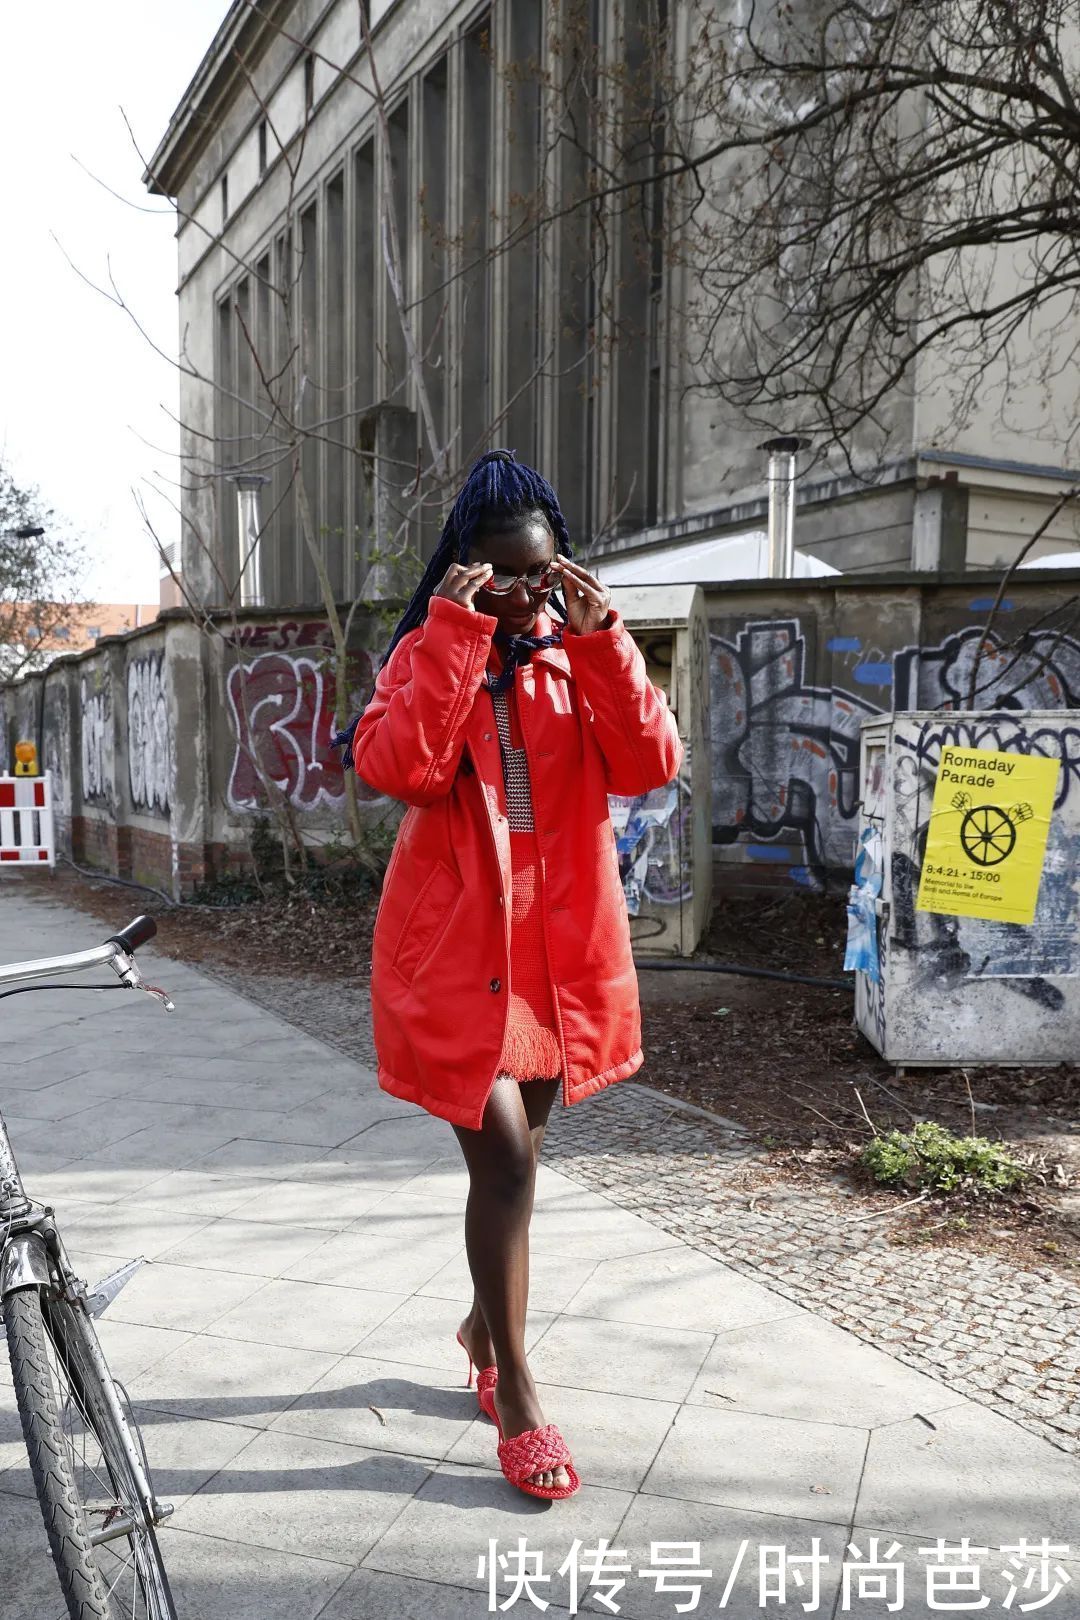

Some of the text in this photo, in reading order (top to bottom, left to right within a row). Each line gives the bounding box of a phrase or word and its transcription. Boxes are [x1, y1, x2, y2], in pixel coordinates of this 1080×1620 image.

[944, 752, 1015, 775] Romaday
[941, 769, 995, 788] Parade
[926, 865, 1001, 882] 8.4.21 15:00
[925, 878, 955, 887] Memorial
[979, 893, 1002, 901] Europe
